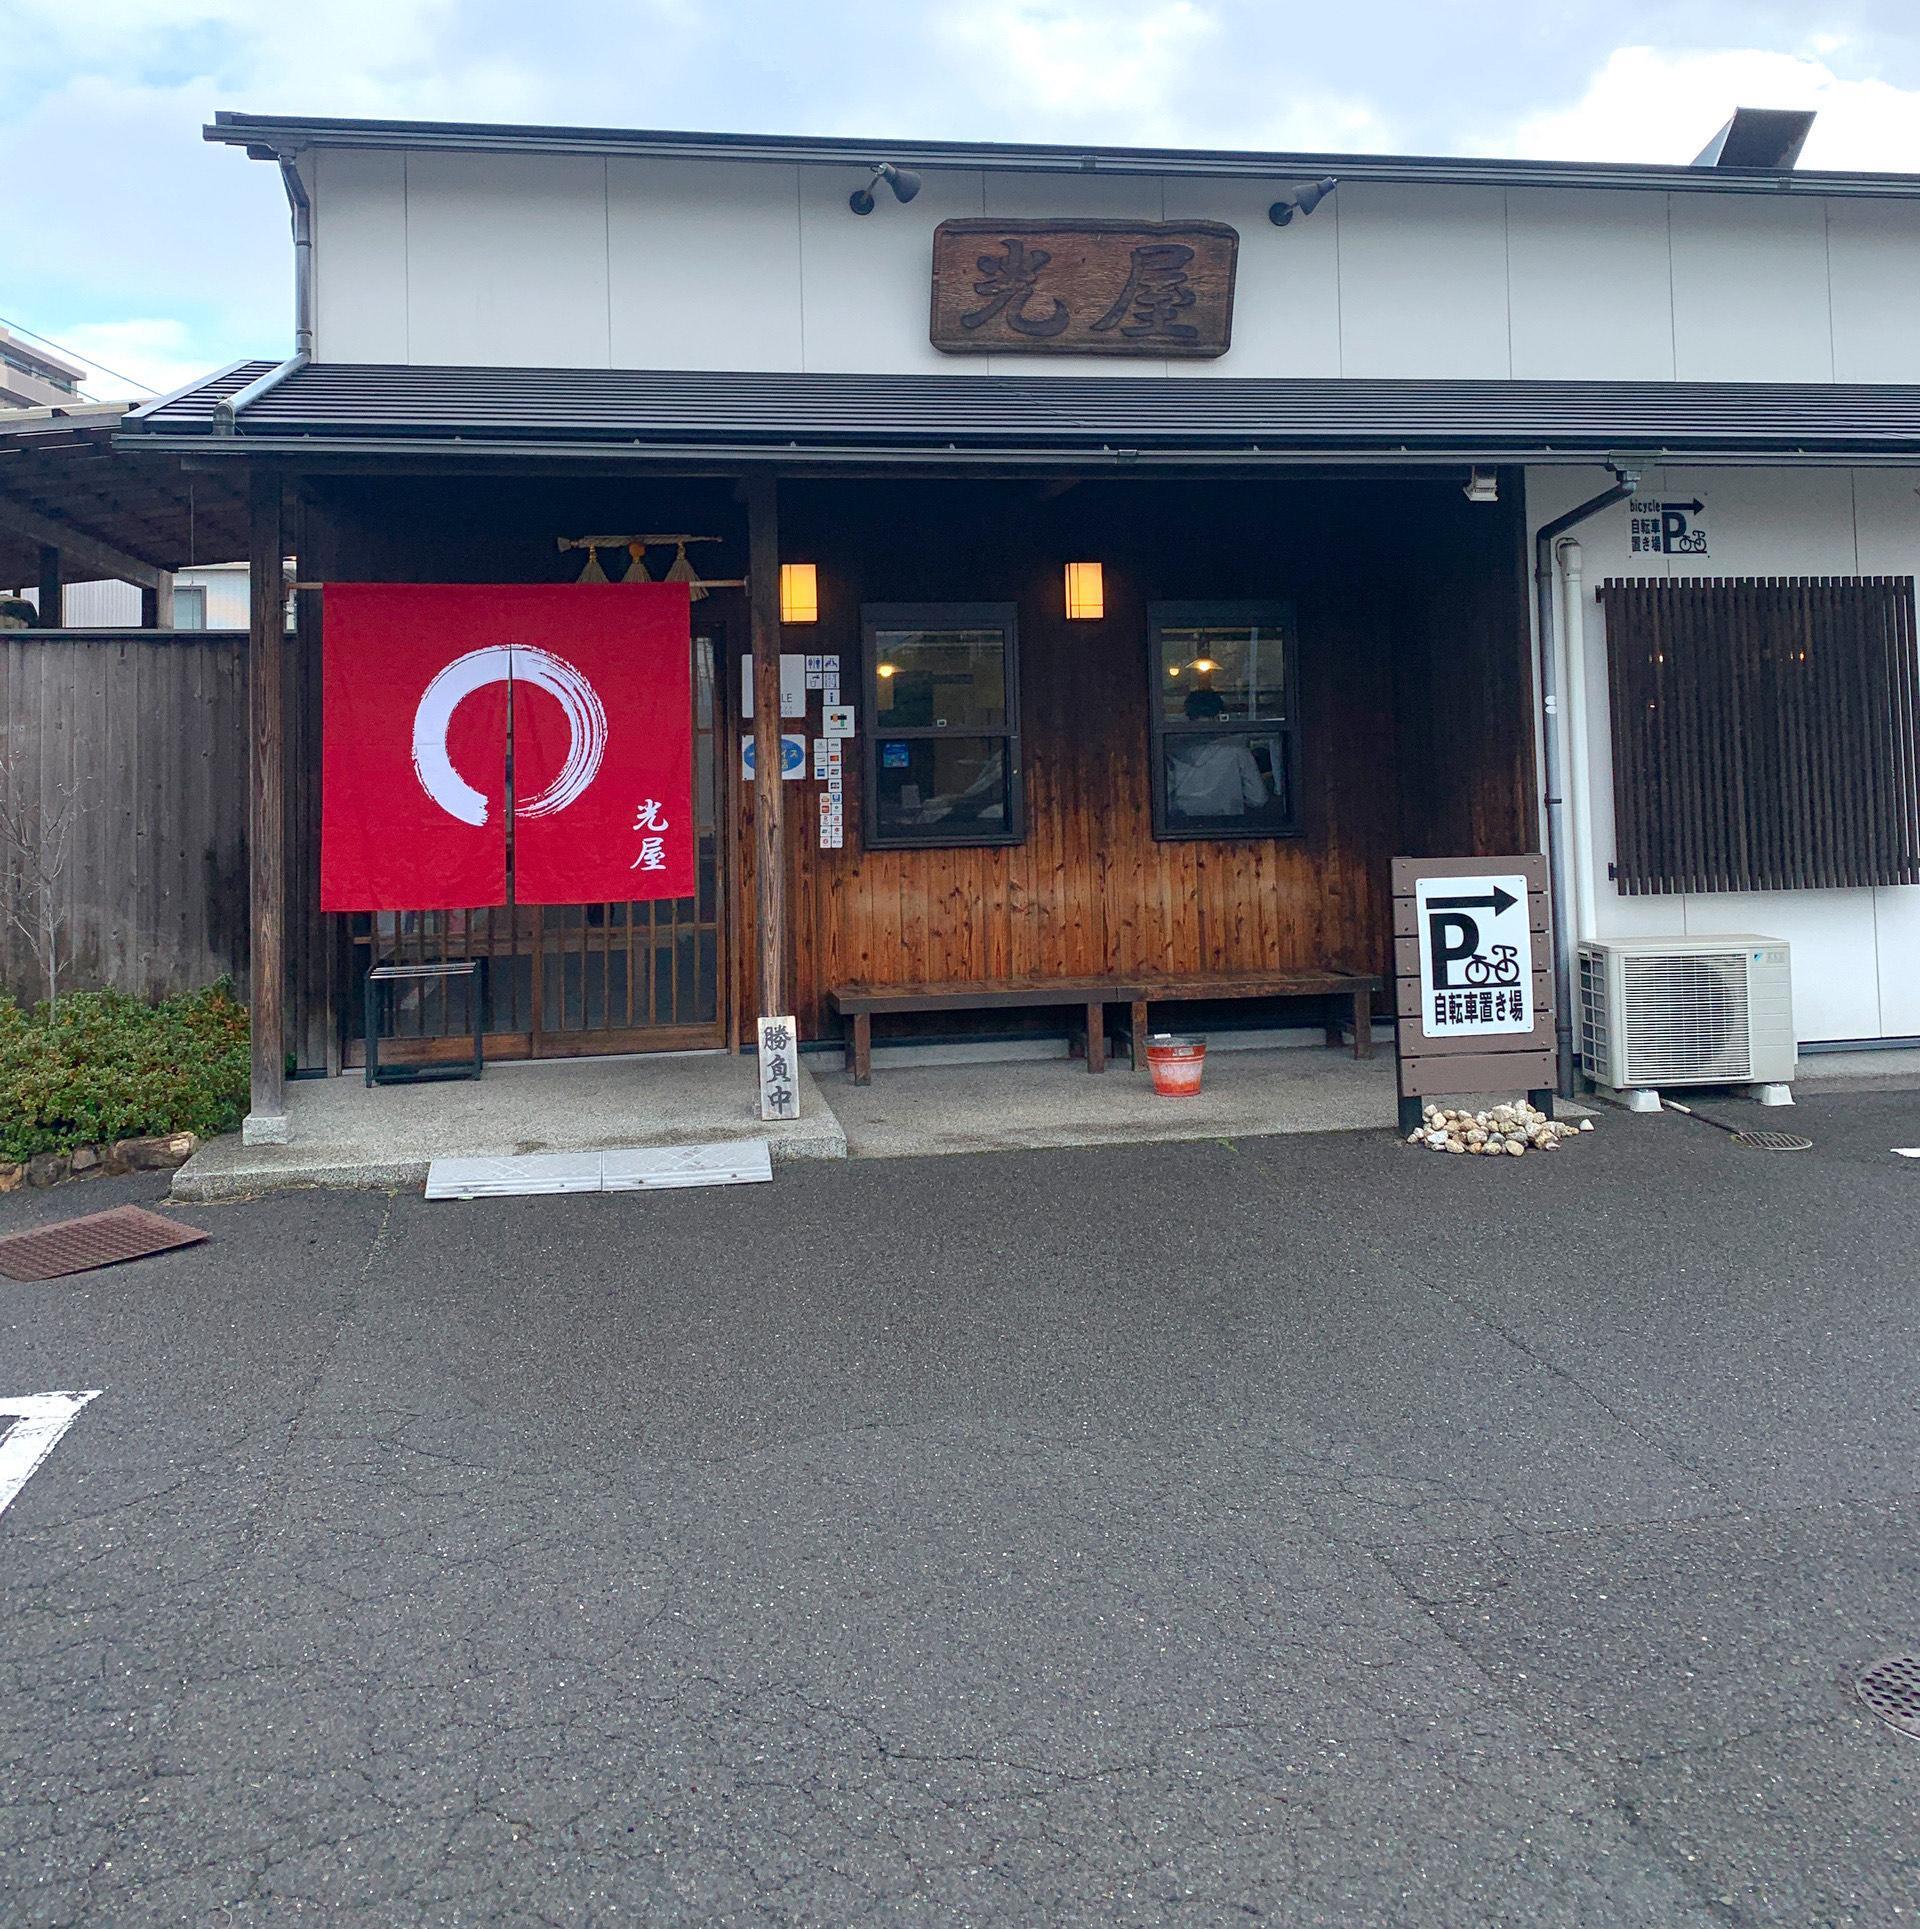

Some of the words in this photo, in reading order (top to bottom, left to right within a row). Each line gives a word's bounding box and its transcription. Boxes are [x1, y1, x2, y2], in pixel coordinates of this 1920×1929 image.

[960, 238, 1198, 338] 光屋
[1630, 500, 1660, 512] bicycle
[1631, 519, 1660, 534] 自転車
[1632, 536, 1661, 552] 置き場
[1662, 512, 1687, 553] P
[630, 799, 669, 871] 光屋
[1429, 912, 1480, 990] P
[1434, 990, 1523, 1026] 自転車置き場
[763, 1024, 793, 1115] 勝負中
